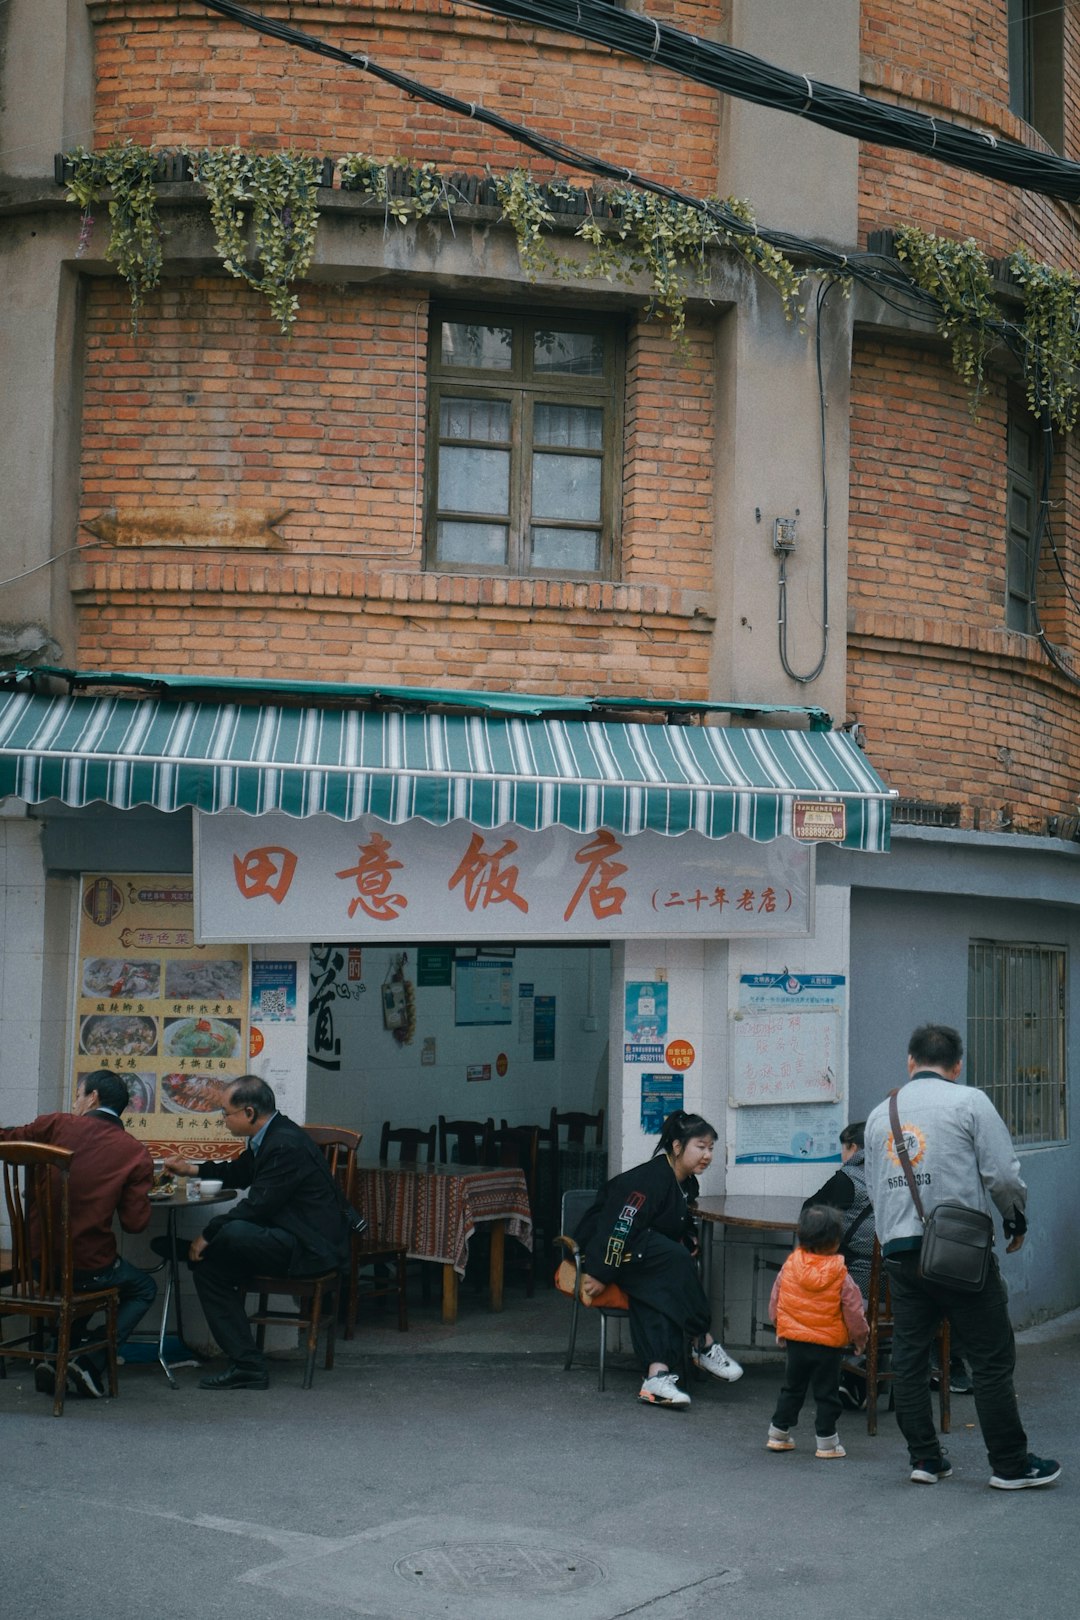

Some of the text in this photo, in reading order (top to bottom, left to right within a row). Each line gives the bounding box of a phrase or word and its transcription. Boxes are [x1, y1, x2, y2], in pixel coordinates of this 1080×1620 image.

[233, 830, 628, 922] 田意饭店
[139, 932, 190, 945] 特色菜
[671, 1056, 691, 1067] 10号
